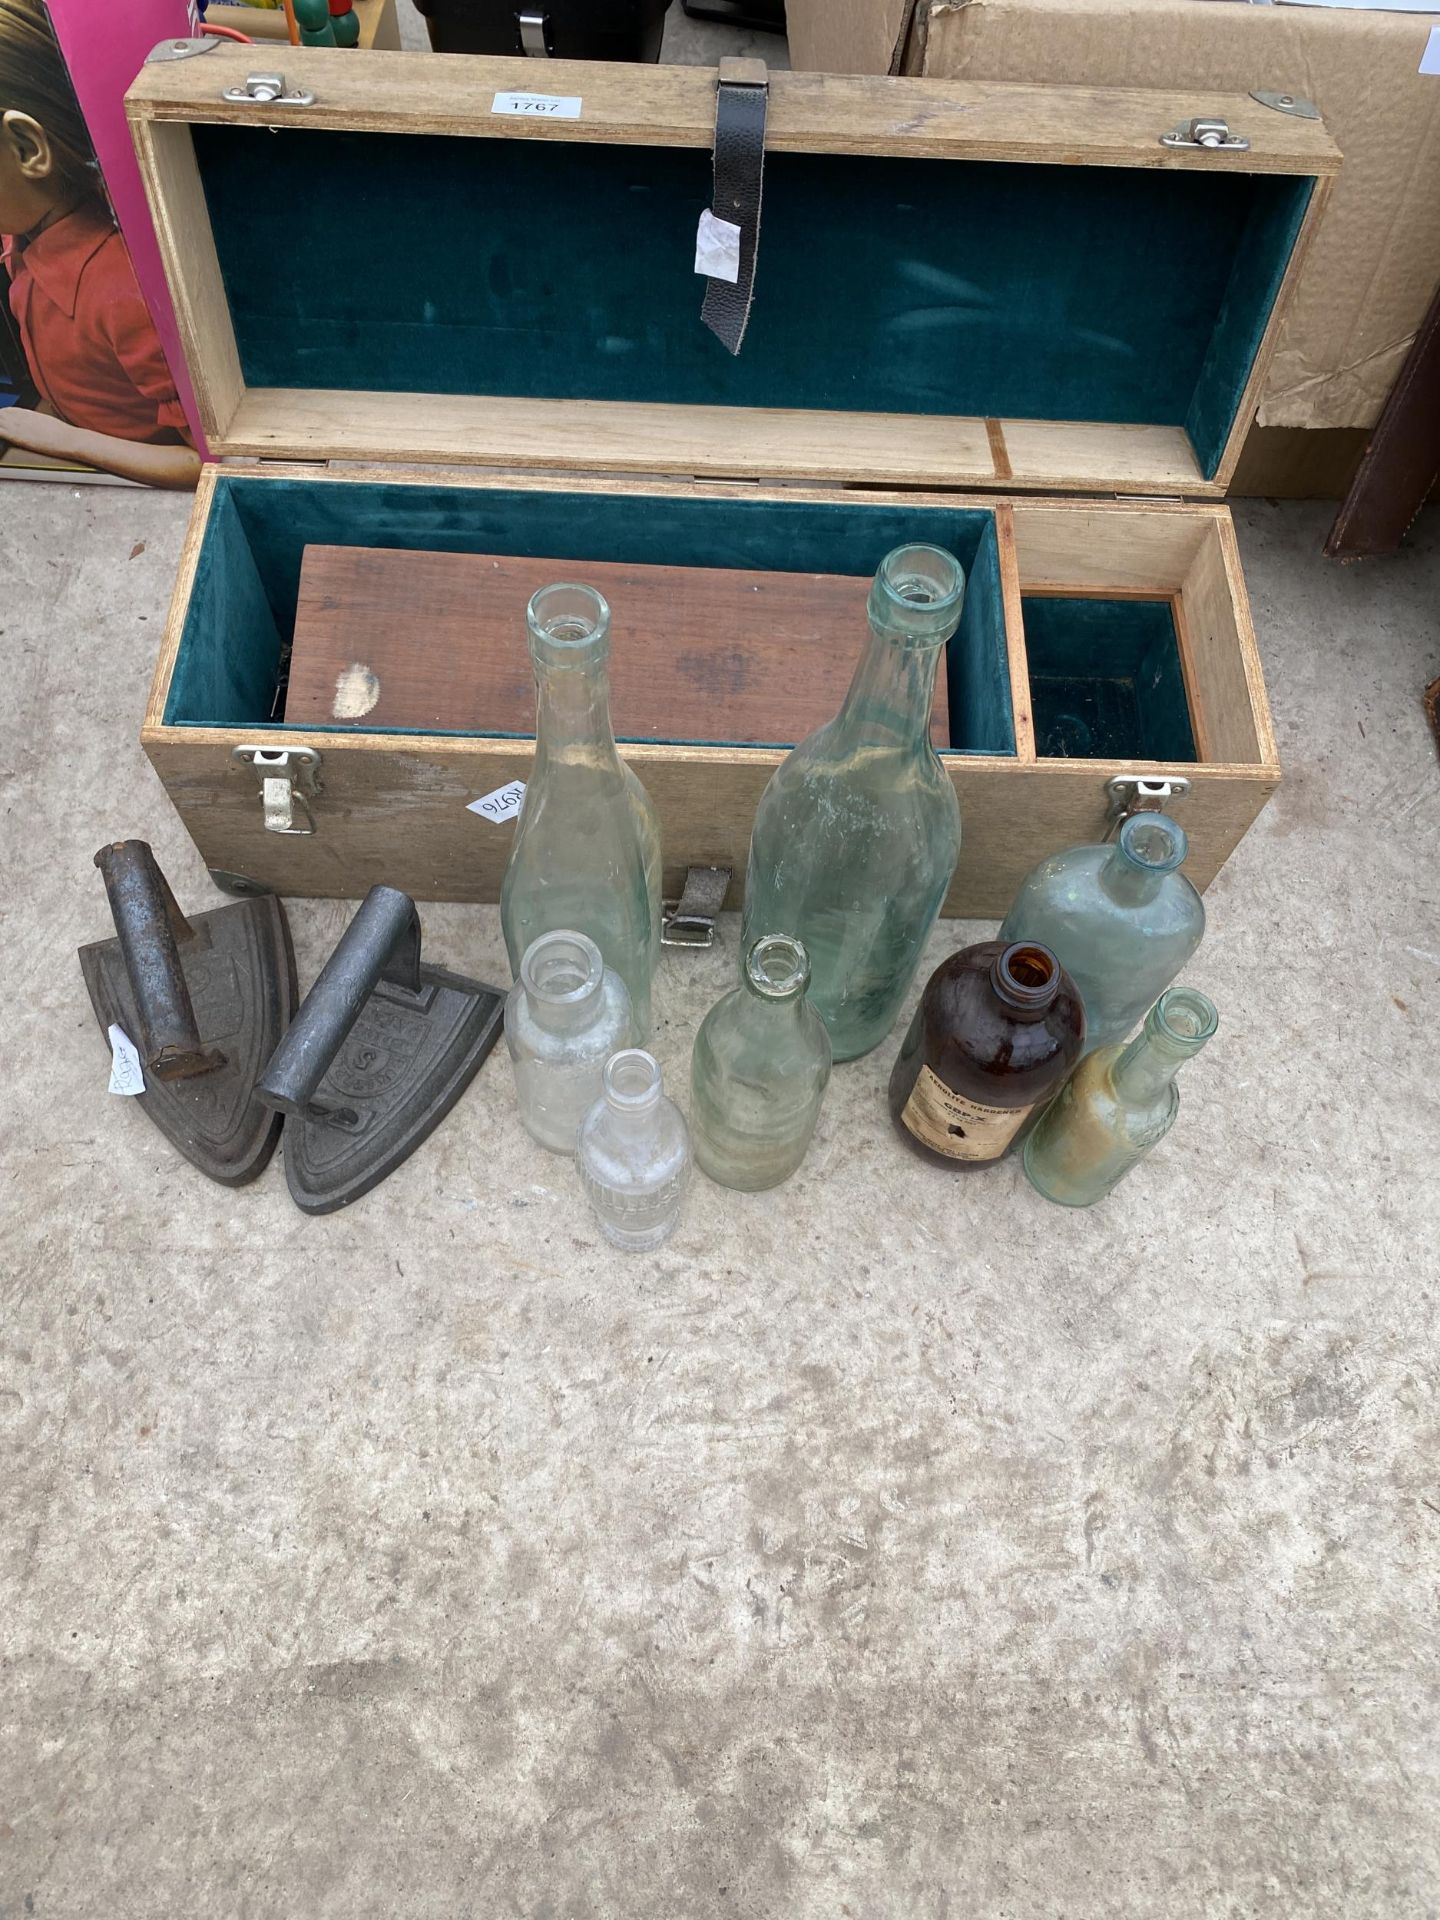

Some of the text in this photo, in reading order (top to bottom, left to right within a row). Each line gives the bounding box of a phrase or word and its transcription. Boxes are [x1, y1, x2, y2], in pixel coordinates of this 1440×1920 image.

[511, 102, 559, 111] 1767
[928, 1074, 1023, 1116] AEROLITE HARDENER
